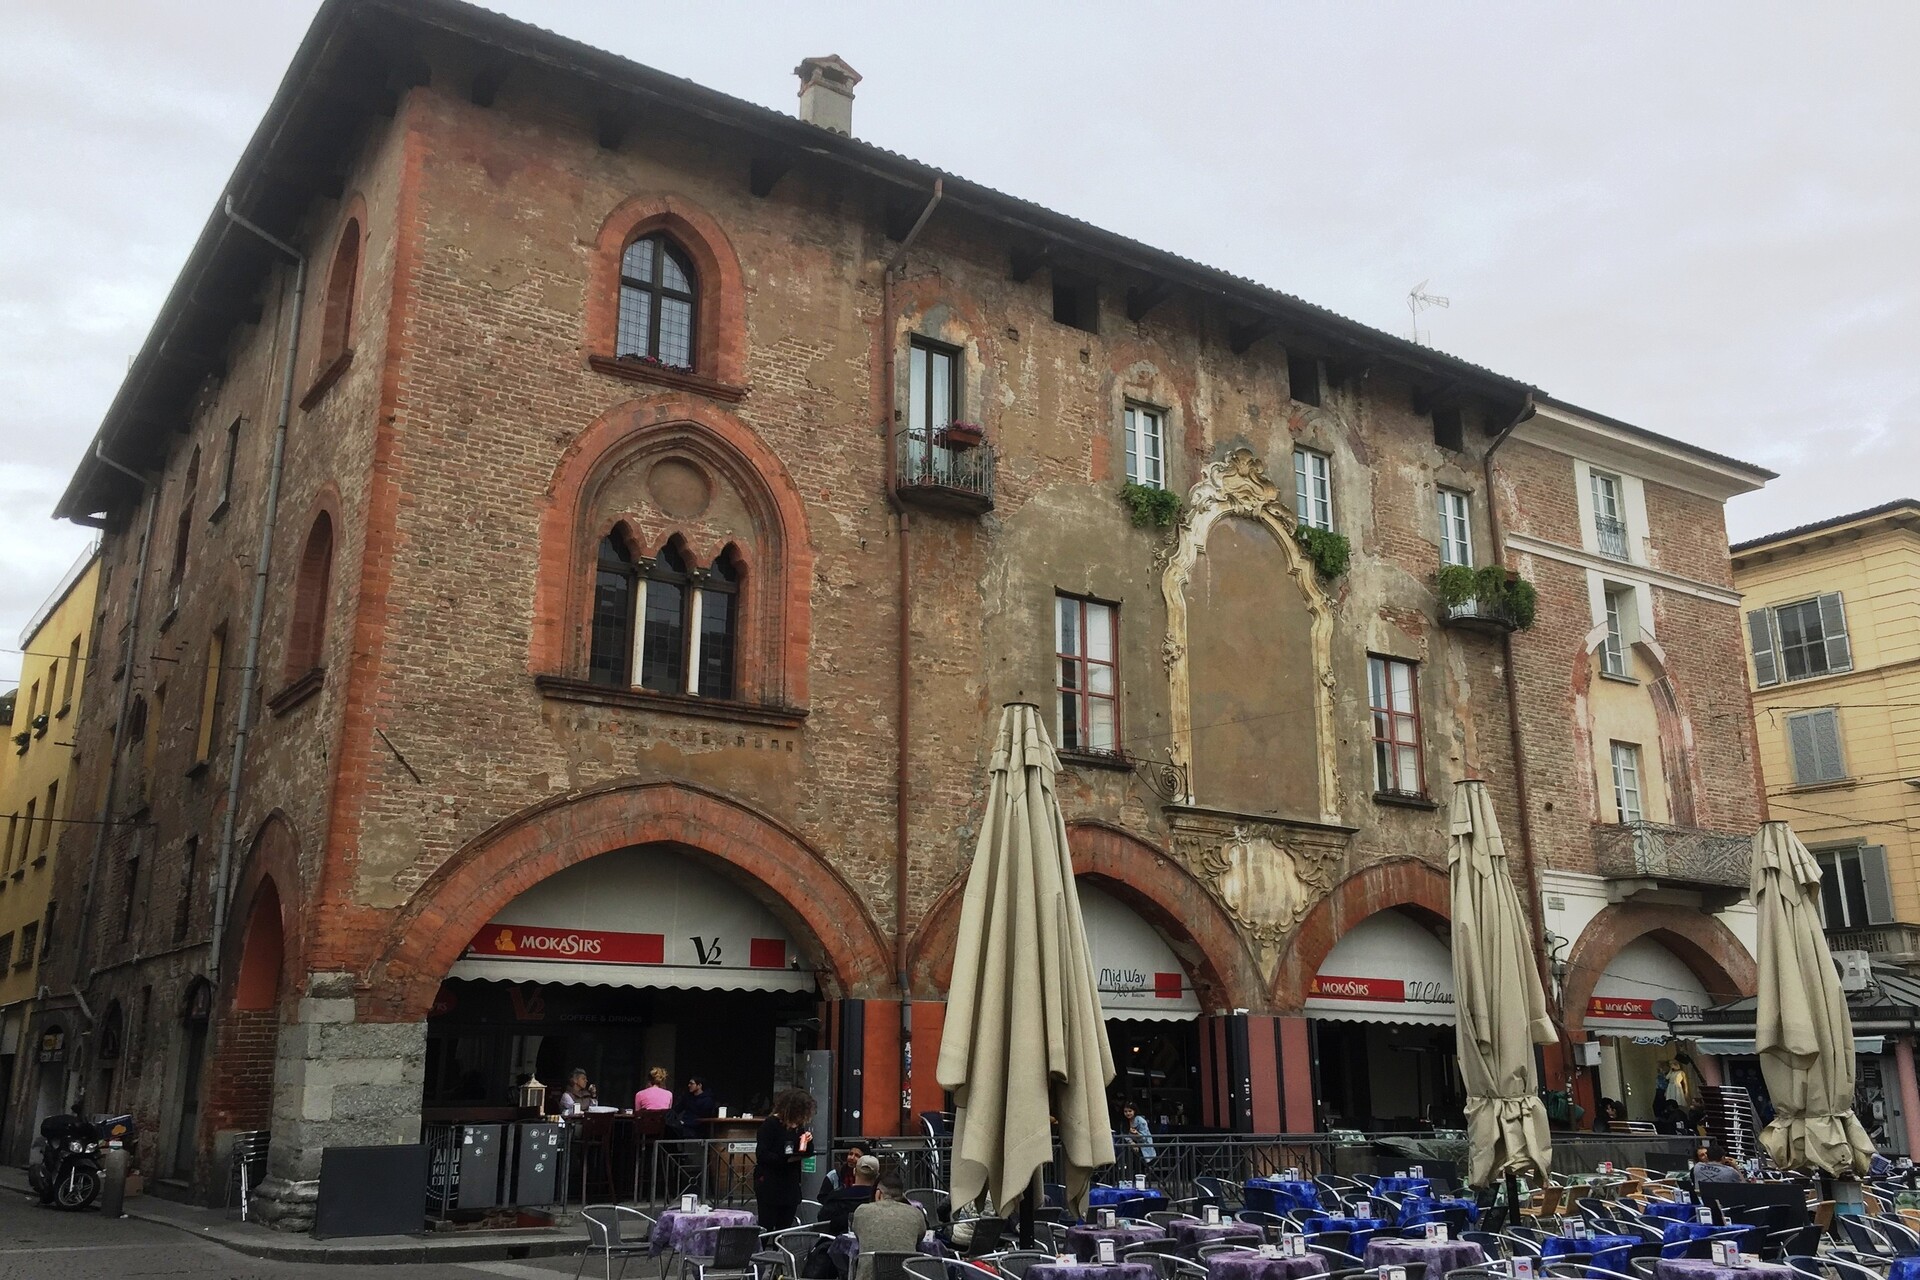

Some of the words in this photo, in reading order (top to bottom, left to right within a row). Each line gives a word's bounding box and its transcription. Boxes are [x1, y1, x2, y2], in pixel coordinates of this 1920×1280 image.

[520, 934, 602, 955] MOKASIRS
[1099, 968, 1121, 986] Mid
[1124, 968, 1146, 987] Way
[1322, 981, 1369, 996] MOKASIRS
